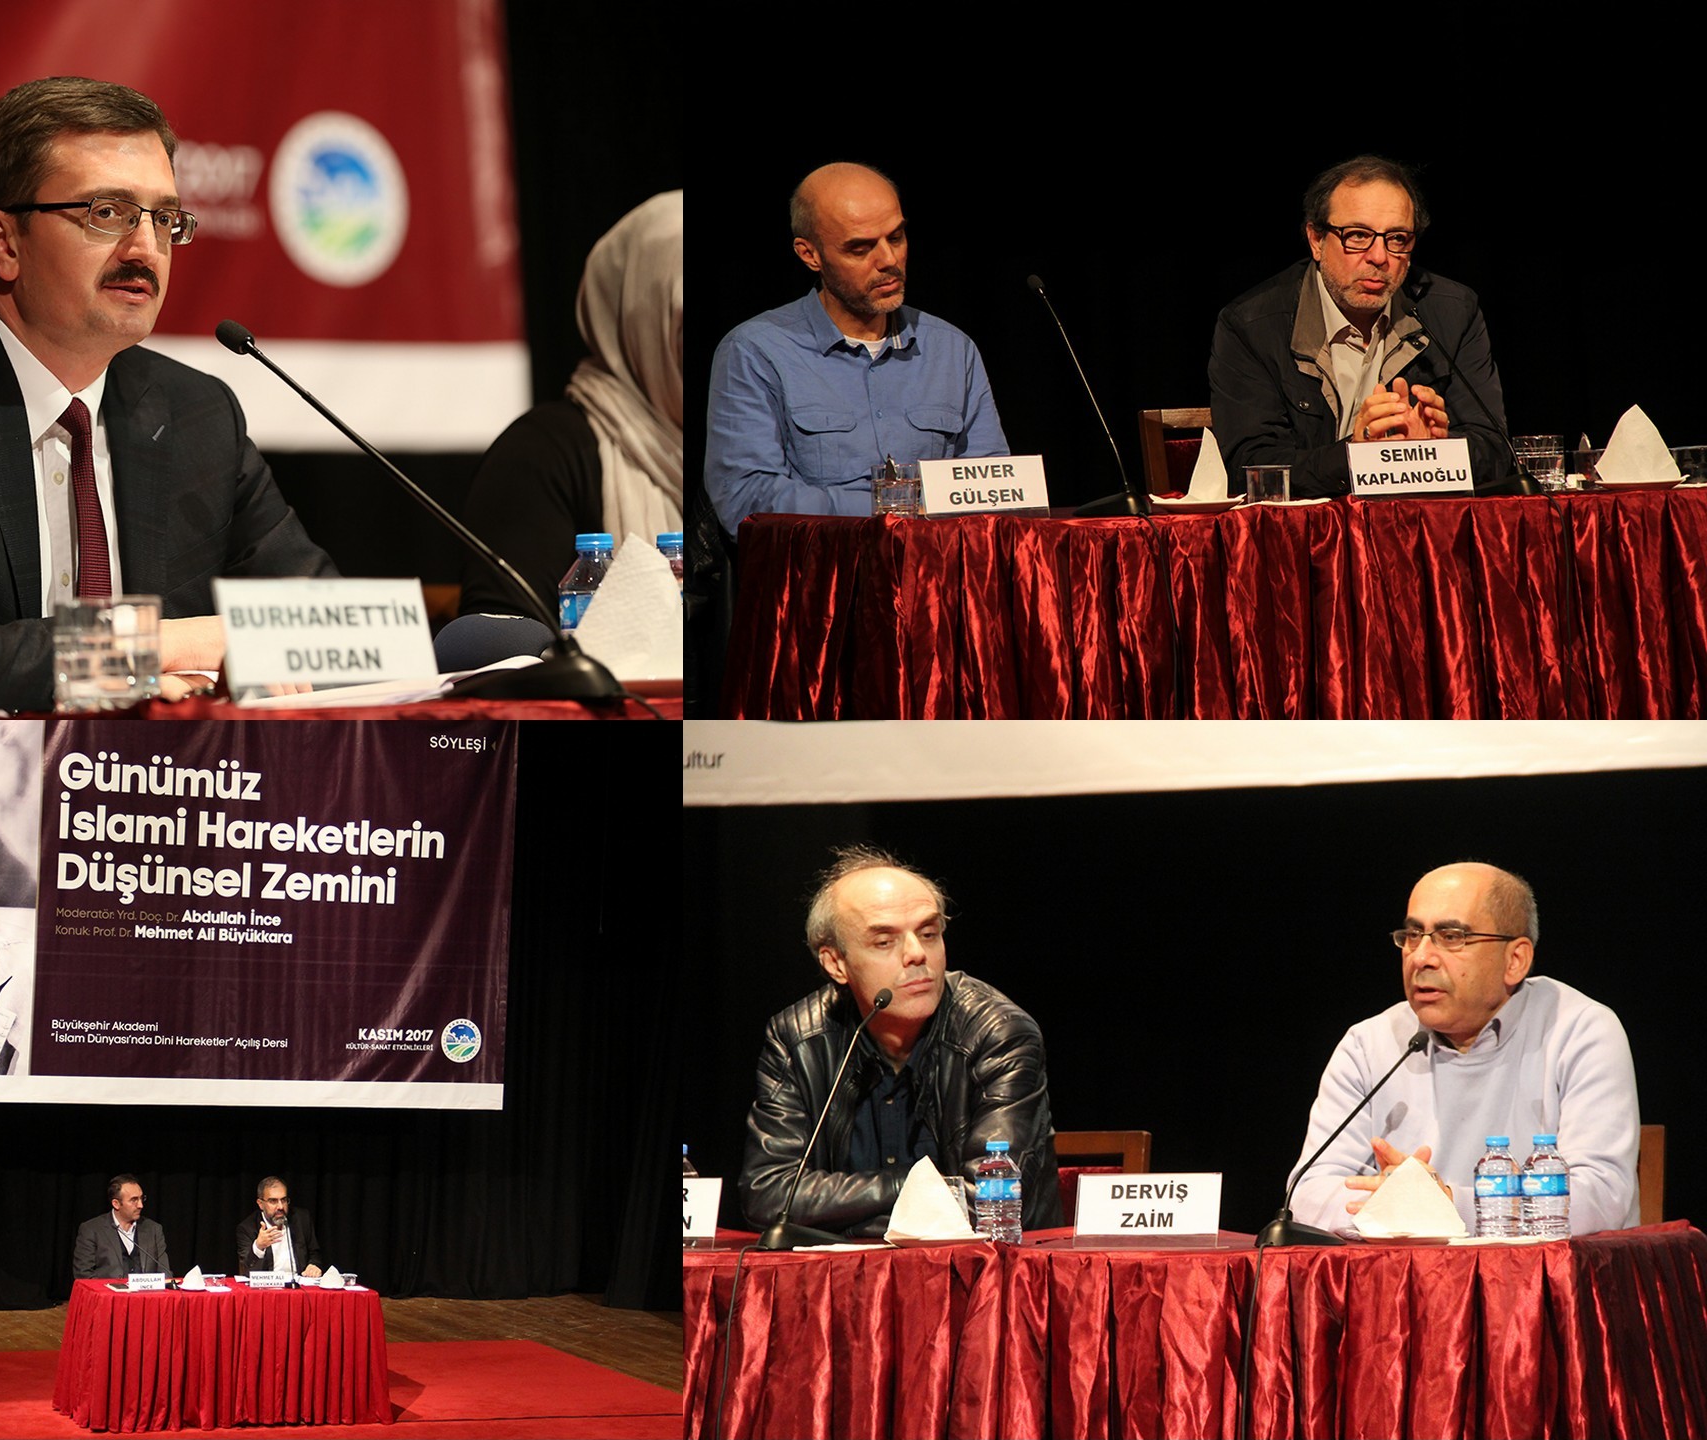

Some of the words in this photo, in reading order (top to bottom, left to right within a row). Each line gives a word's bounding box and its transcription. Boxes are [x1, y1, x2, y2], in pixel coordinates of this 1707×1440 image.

[1380, 445, 1437, 462] SEMİH
[952, 464, 1015, 480] ENVER
[1356, 467, 1467, 486] KAPLANOĞLU
[949, 488, 1024, 506] GÜLŞEN
[229, 599, 419, 628] BURHANETTİN
[287, 648, 382, 672] DURAN
[429, 735, 487, 753] SÖYLEŞİ
[58, 750, 262, 801] Günümüz
[58, 791, 187, 846] İslami
[197, 811, 445, 859] Hareketlerin
[56, 851, 252, 905] Düşünsel
[260, 863, 397, 904] Zemini
[56, 907, 114, 920] Moderatör:
[117, 910, 136, 921] Yrd.
[140, 911, 163, 924] Doç.
[166, 912, 179, 922] Dr.
[181, 909, 246, 925] Abdullah
[249, 908, 281, 926] İnce
[55, 925, 90, 936] Konuk:
[93, 926, 116, 937] Prof.
[119, 927, 132, 938] Dr.
[134, 925, 193, 941] Mehmet
[196, 927, 215, 941] Ali
[219, 928, 293, 944] Büyükkara
[51, 1019, 110, 1033] Büyükşehir
[112, 1020, 159, 1031] Akademi
[358, 1028, 403, 1041] KASIM
[405, 1029, 434, 1042] 2017
[154, 1034, 173, 1045] Dini
[235, 1037, 261, 1050] Açılış
[262, 1037, 288, 1048] Dersi
[345, 1042, 391, 1050] KÜLTÜR-SANAT
[1111, 1180, 1189, 1203] DERVİŞ
[1120, 1209, 1174, 1228] ZAİM
